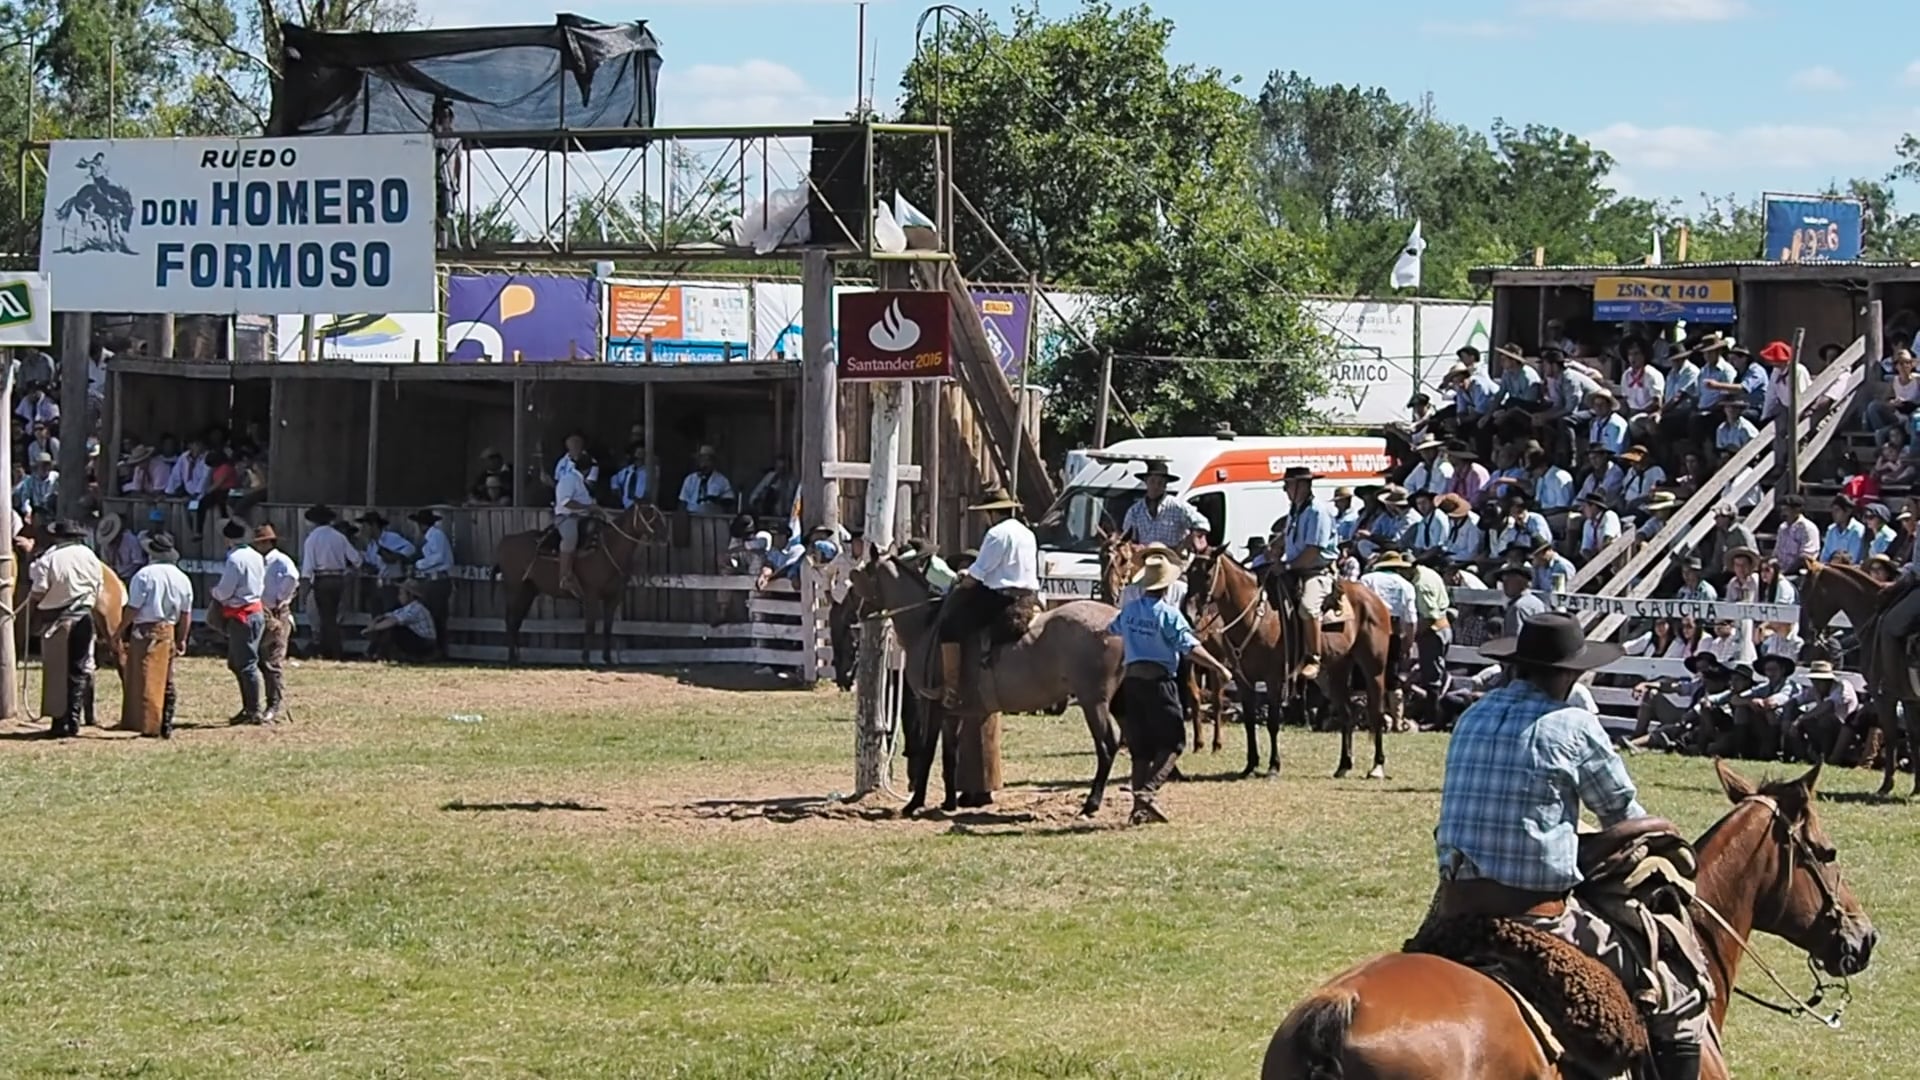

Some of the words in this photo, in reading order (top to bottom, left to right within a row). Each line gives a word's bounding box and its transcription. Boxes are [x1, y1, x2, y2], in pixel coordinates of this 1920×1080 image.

[201, 147, 297, 168] RUEDO
[141, 199, 197, 226] DON
[211, 178, 410, 226] HOMERO
[156, 241, 391, 289] FORMOSO
[1678, 285, 1710, 299] 140
[847, 356, 916, 371] Santander
[915, 352, 943, 368] 2016
[1330, 365, 1388, 382] ARMCO
[1557, 594, 1625, 614] PATRIA
[1635, 600, 1718, 618] GAUCHA
